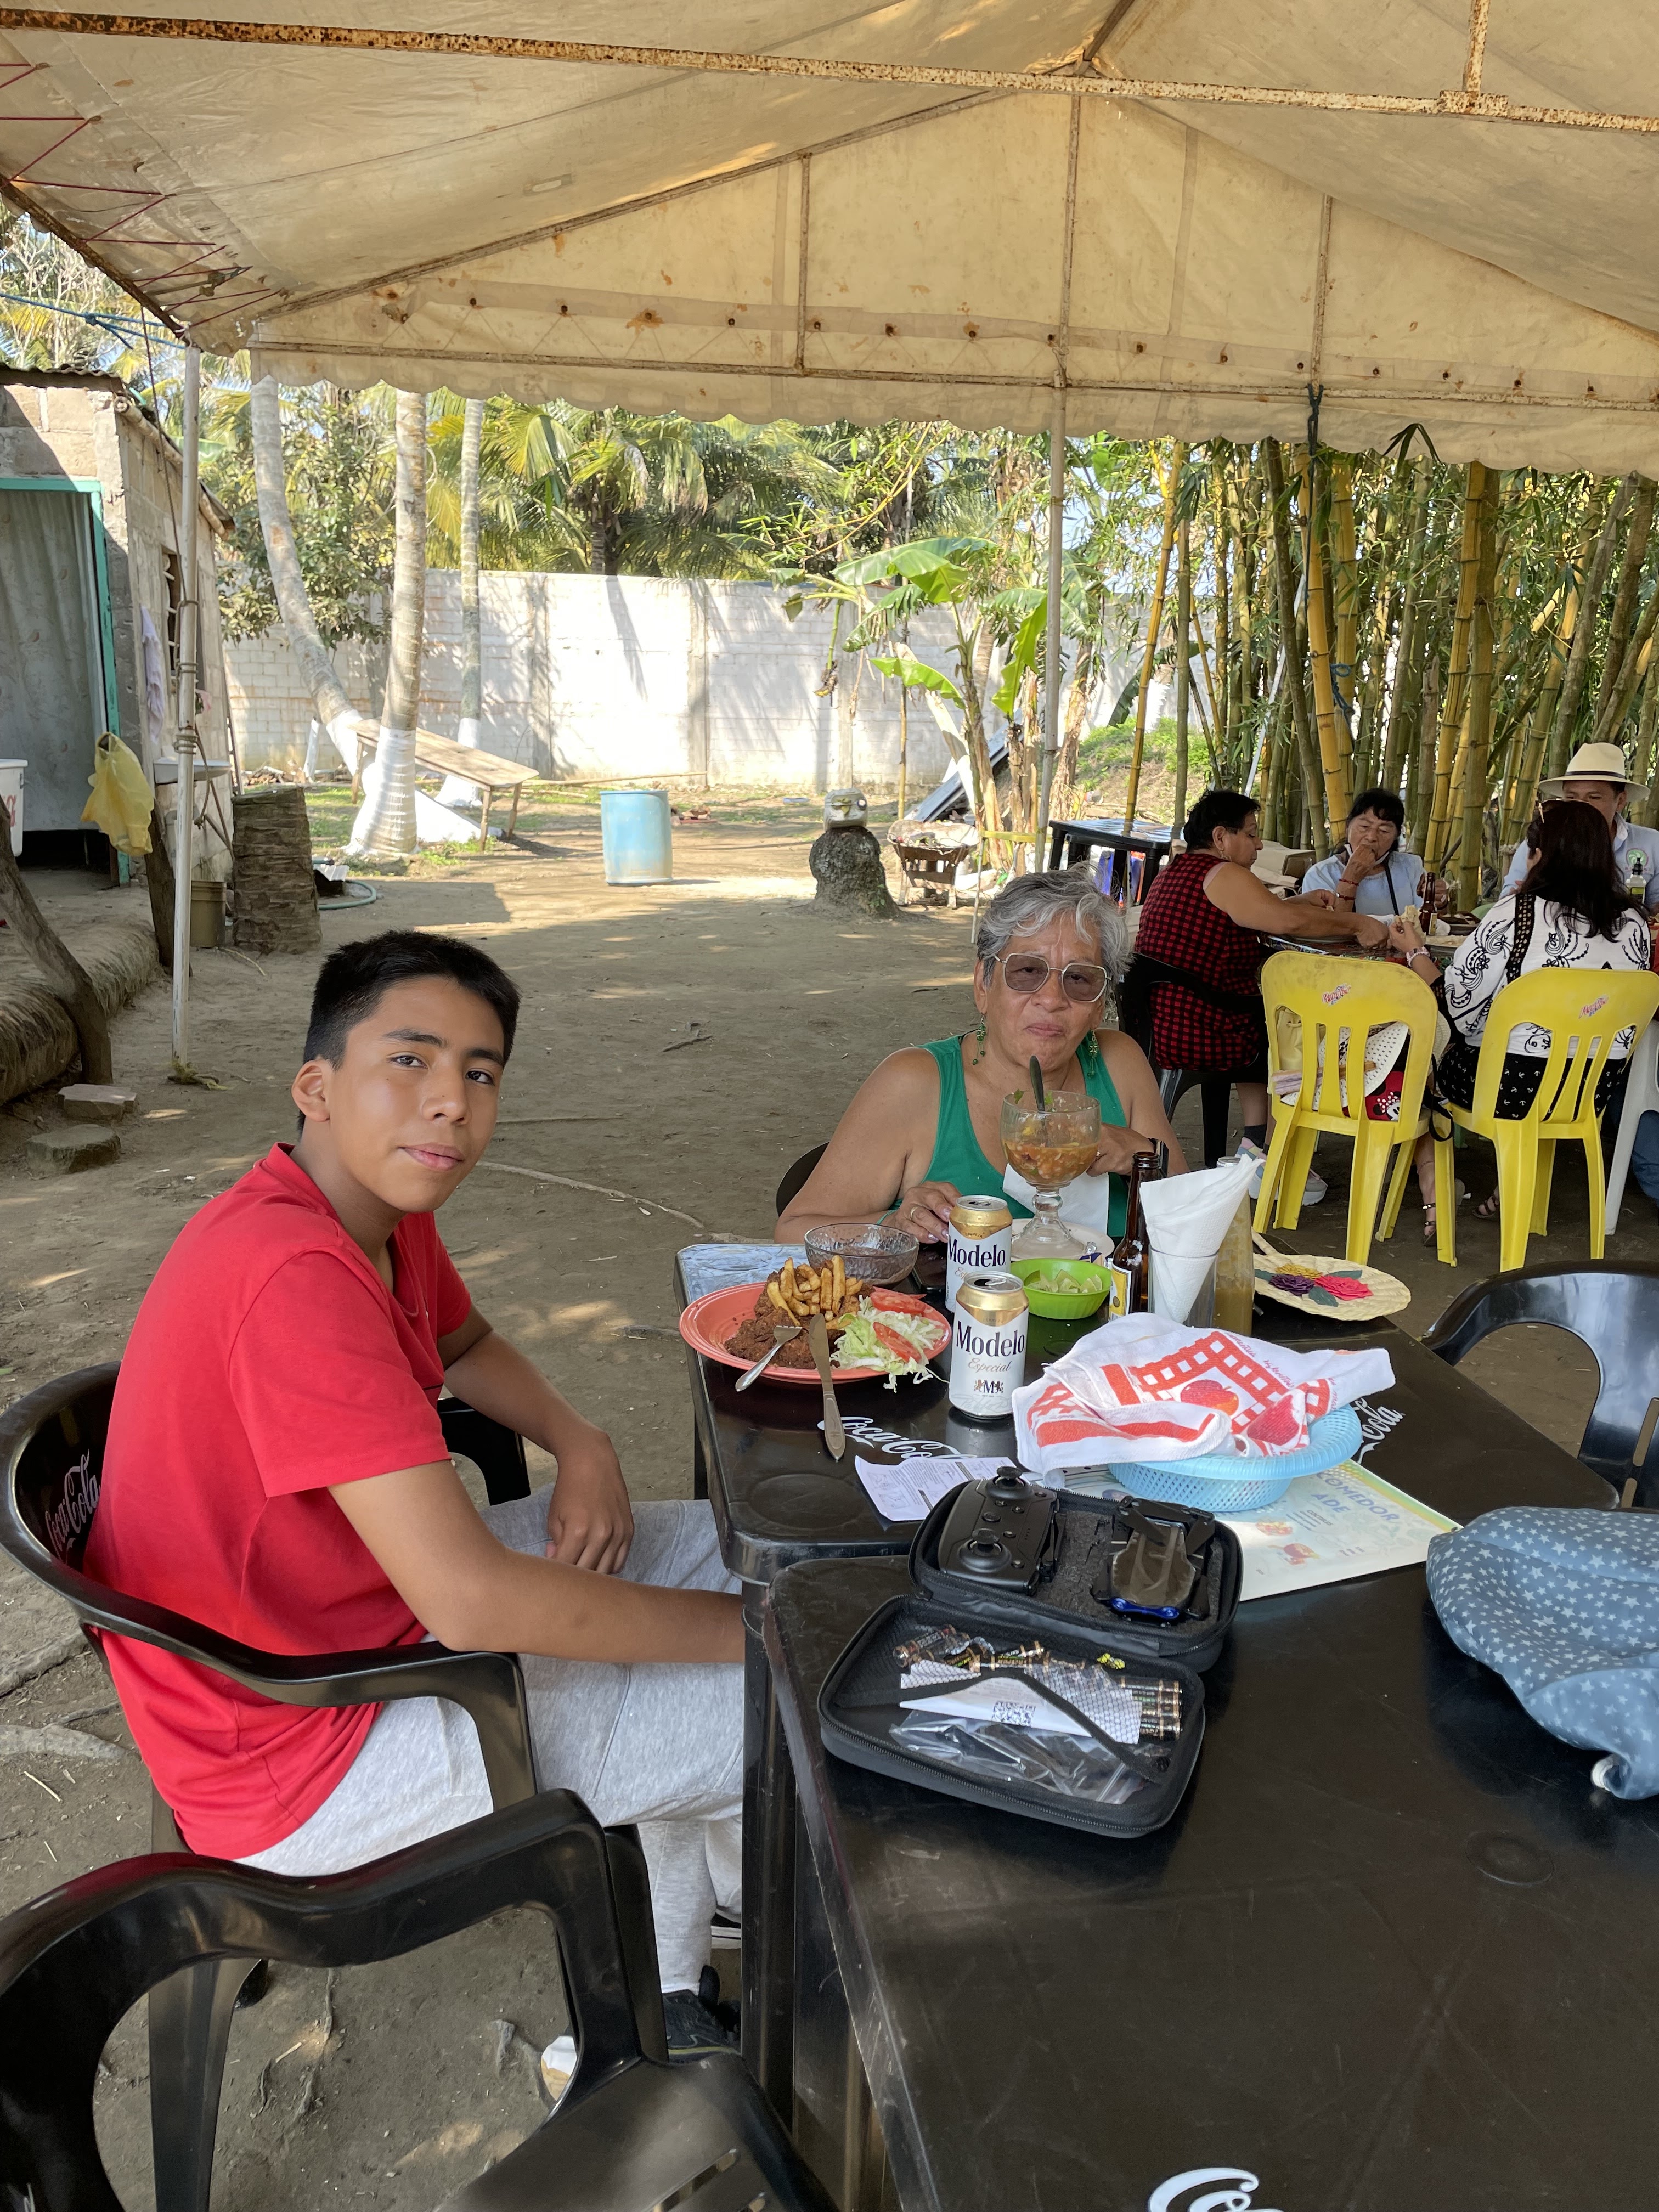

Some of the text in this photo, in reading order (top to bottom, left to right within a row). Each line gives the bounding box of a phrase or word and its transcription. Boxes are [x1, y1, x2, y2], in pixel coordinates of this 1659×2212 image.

[948, 1235, 1006, 1267] Modelo
[956, 1320, 1025, 1357] Modelo
[968, 1357, 1012, 1373] Especial
[1316, 1471, 1400, 1521] COMEDOR
